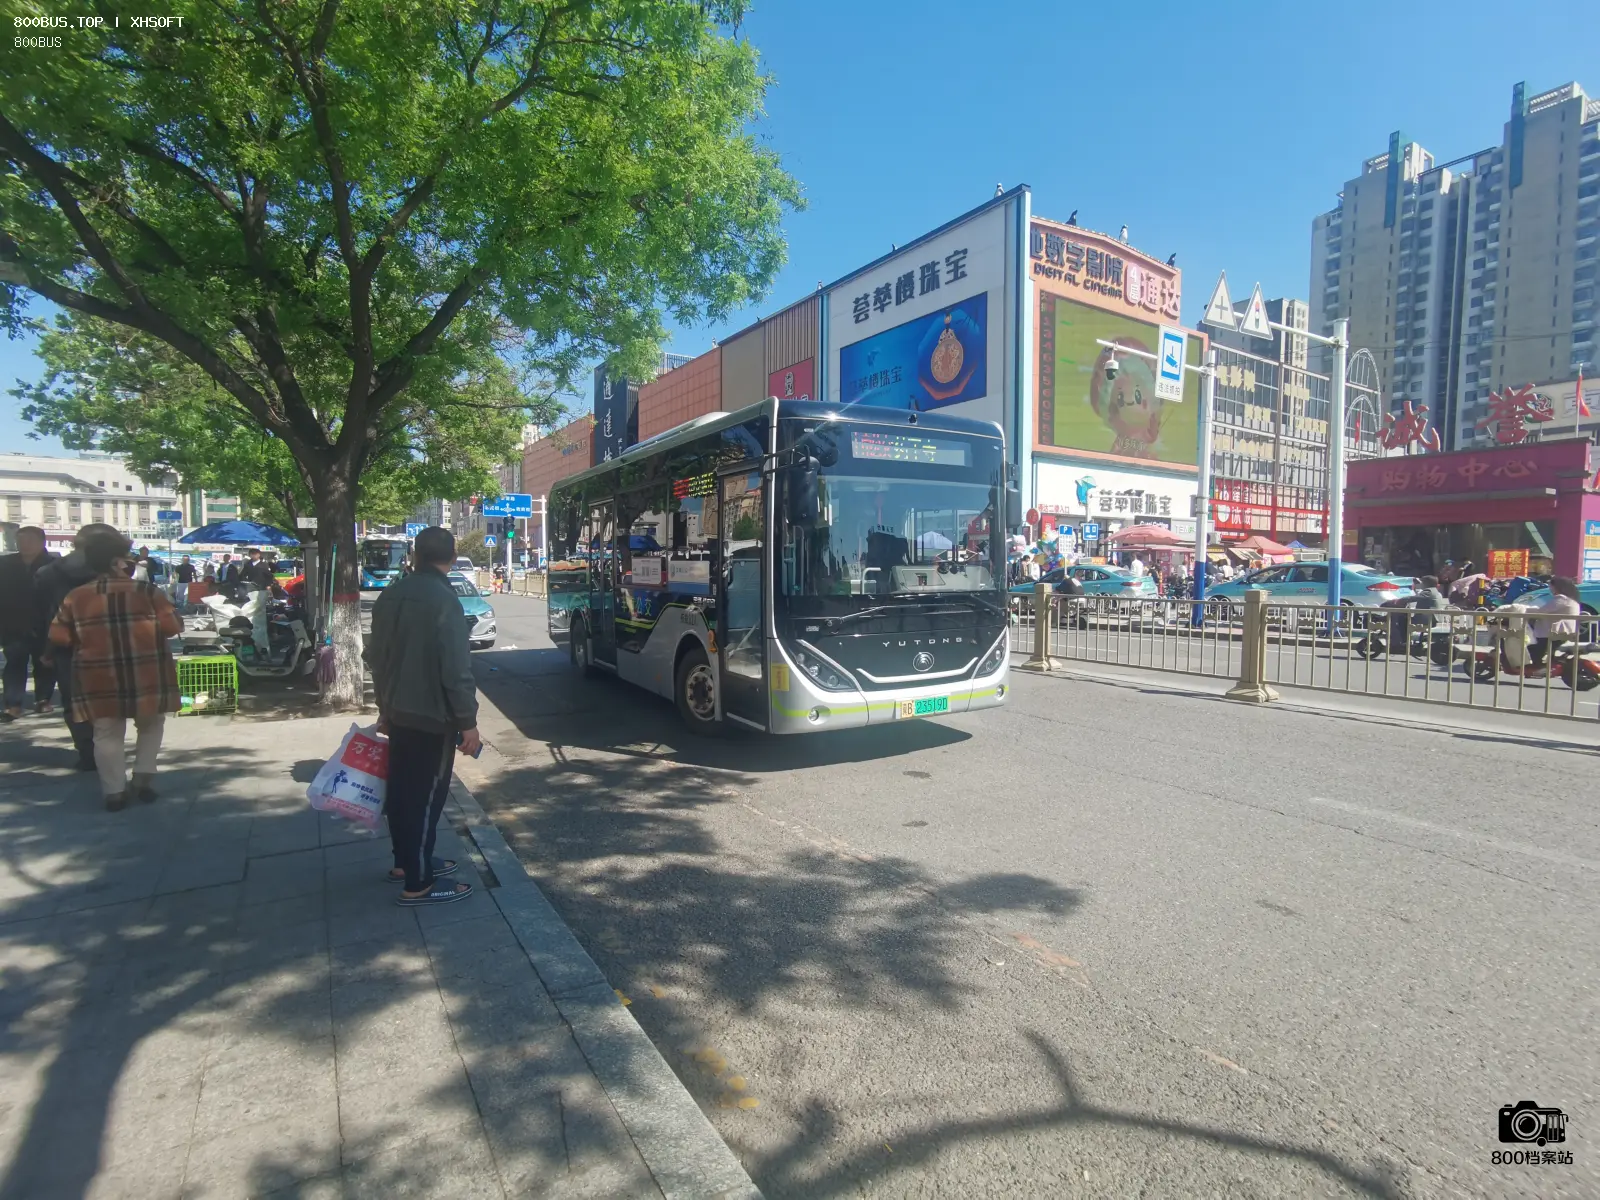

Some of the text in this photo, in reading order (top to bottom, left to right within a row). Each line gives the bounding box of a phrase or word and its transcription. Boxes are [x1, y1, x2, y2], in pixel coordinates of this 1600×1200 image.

[1380, 457, 1538, 492] 购物中心
[882, 637, 963, 648] YUTONG
